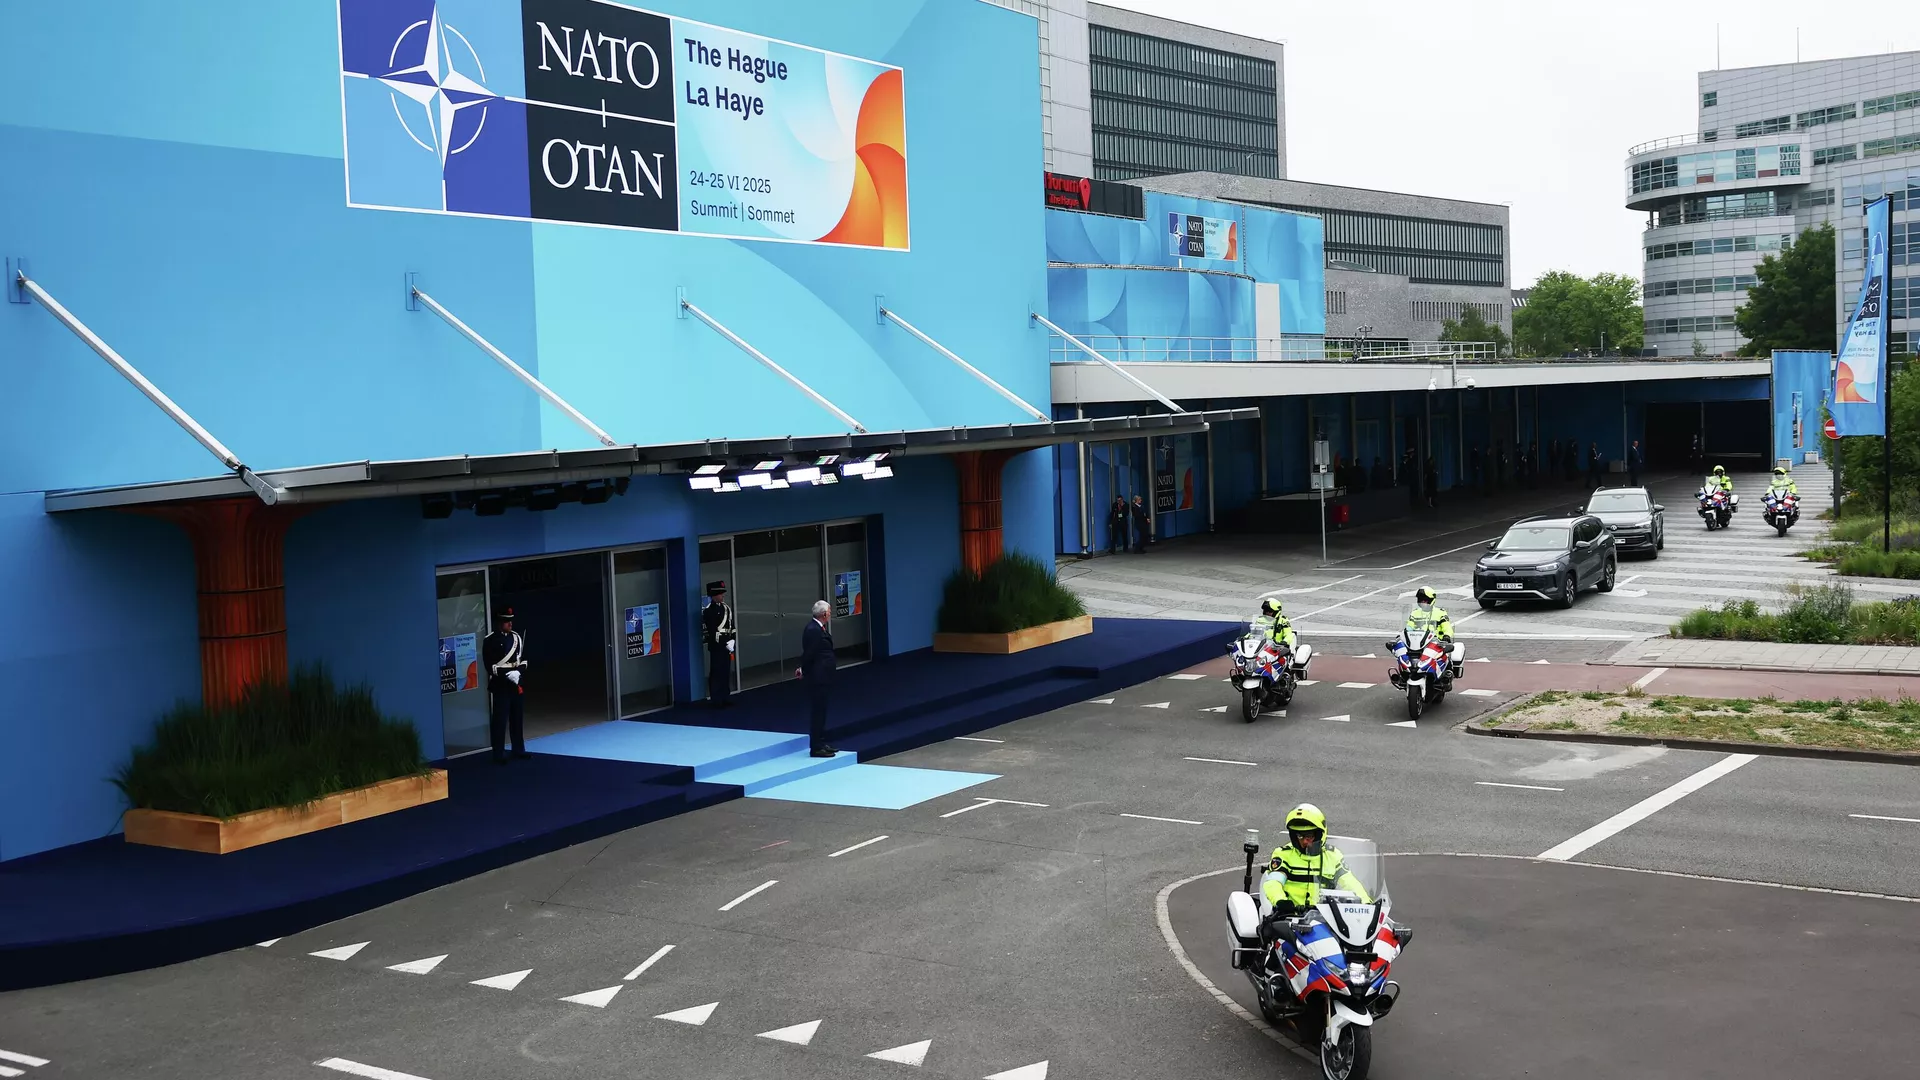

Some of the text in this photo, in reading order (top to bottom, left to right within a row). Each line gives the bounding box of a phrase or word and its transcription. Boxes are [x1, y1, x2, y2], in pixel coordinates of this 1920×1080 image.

[537, 21, 660, 90] NATO
[684, 38, 788, 84] The Hague
[687, 81, 764, 121] La Haye
[542, 138, 664, 200] OTAN
[690, 170, 772, 195] 24-25 VI 2025
[690, 199, 739, 220] Summit
[747, 205, 795, 224] Sommet
[1188, 221, 1203, 232] NATO
[1188, 241, 1204, 252] OTAN
[1157, 474, 1174, 486] NATO
[1158, 495, 1175, 507] OTAN
[627, 634, 643, 643] NATO
[628, 646, 643, 656] OTAN
